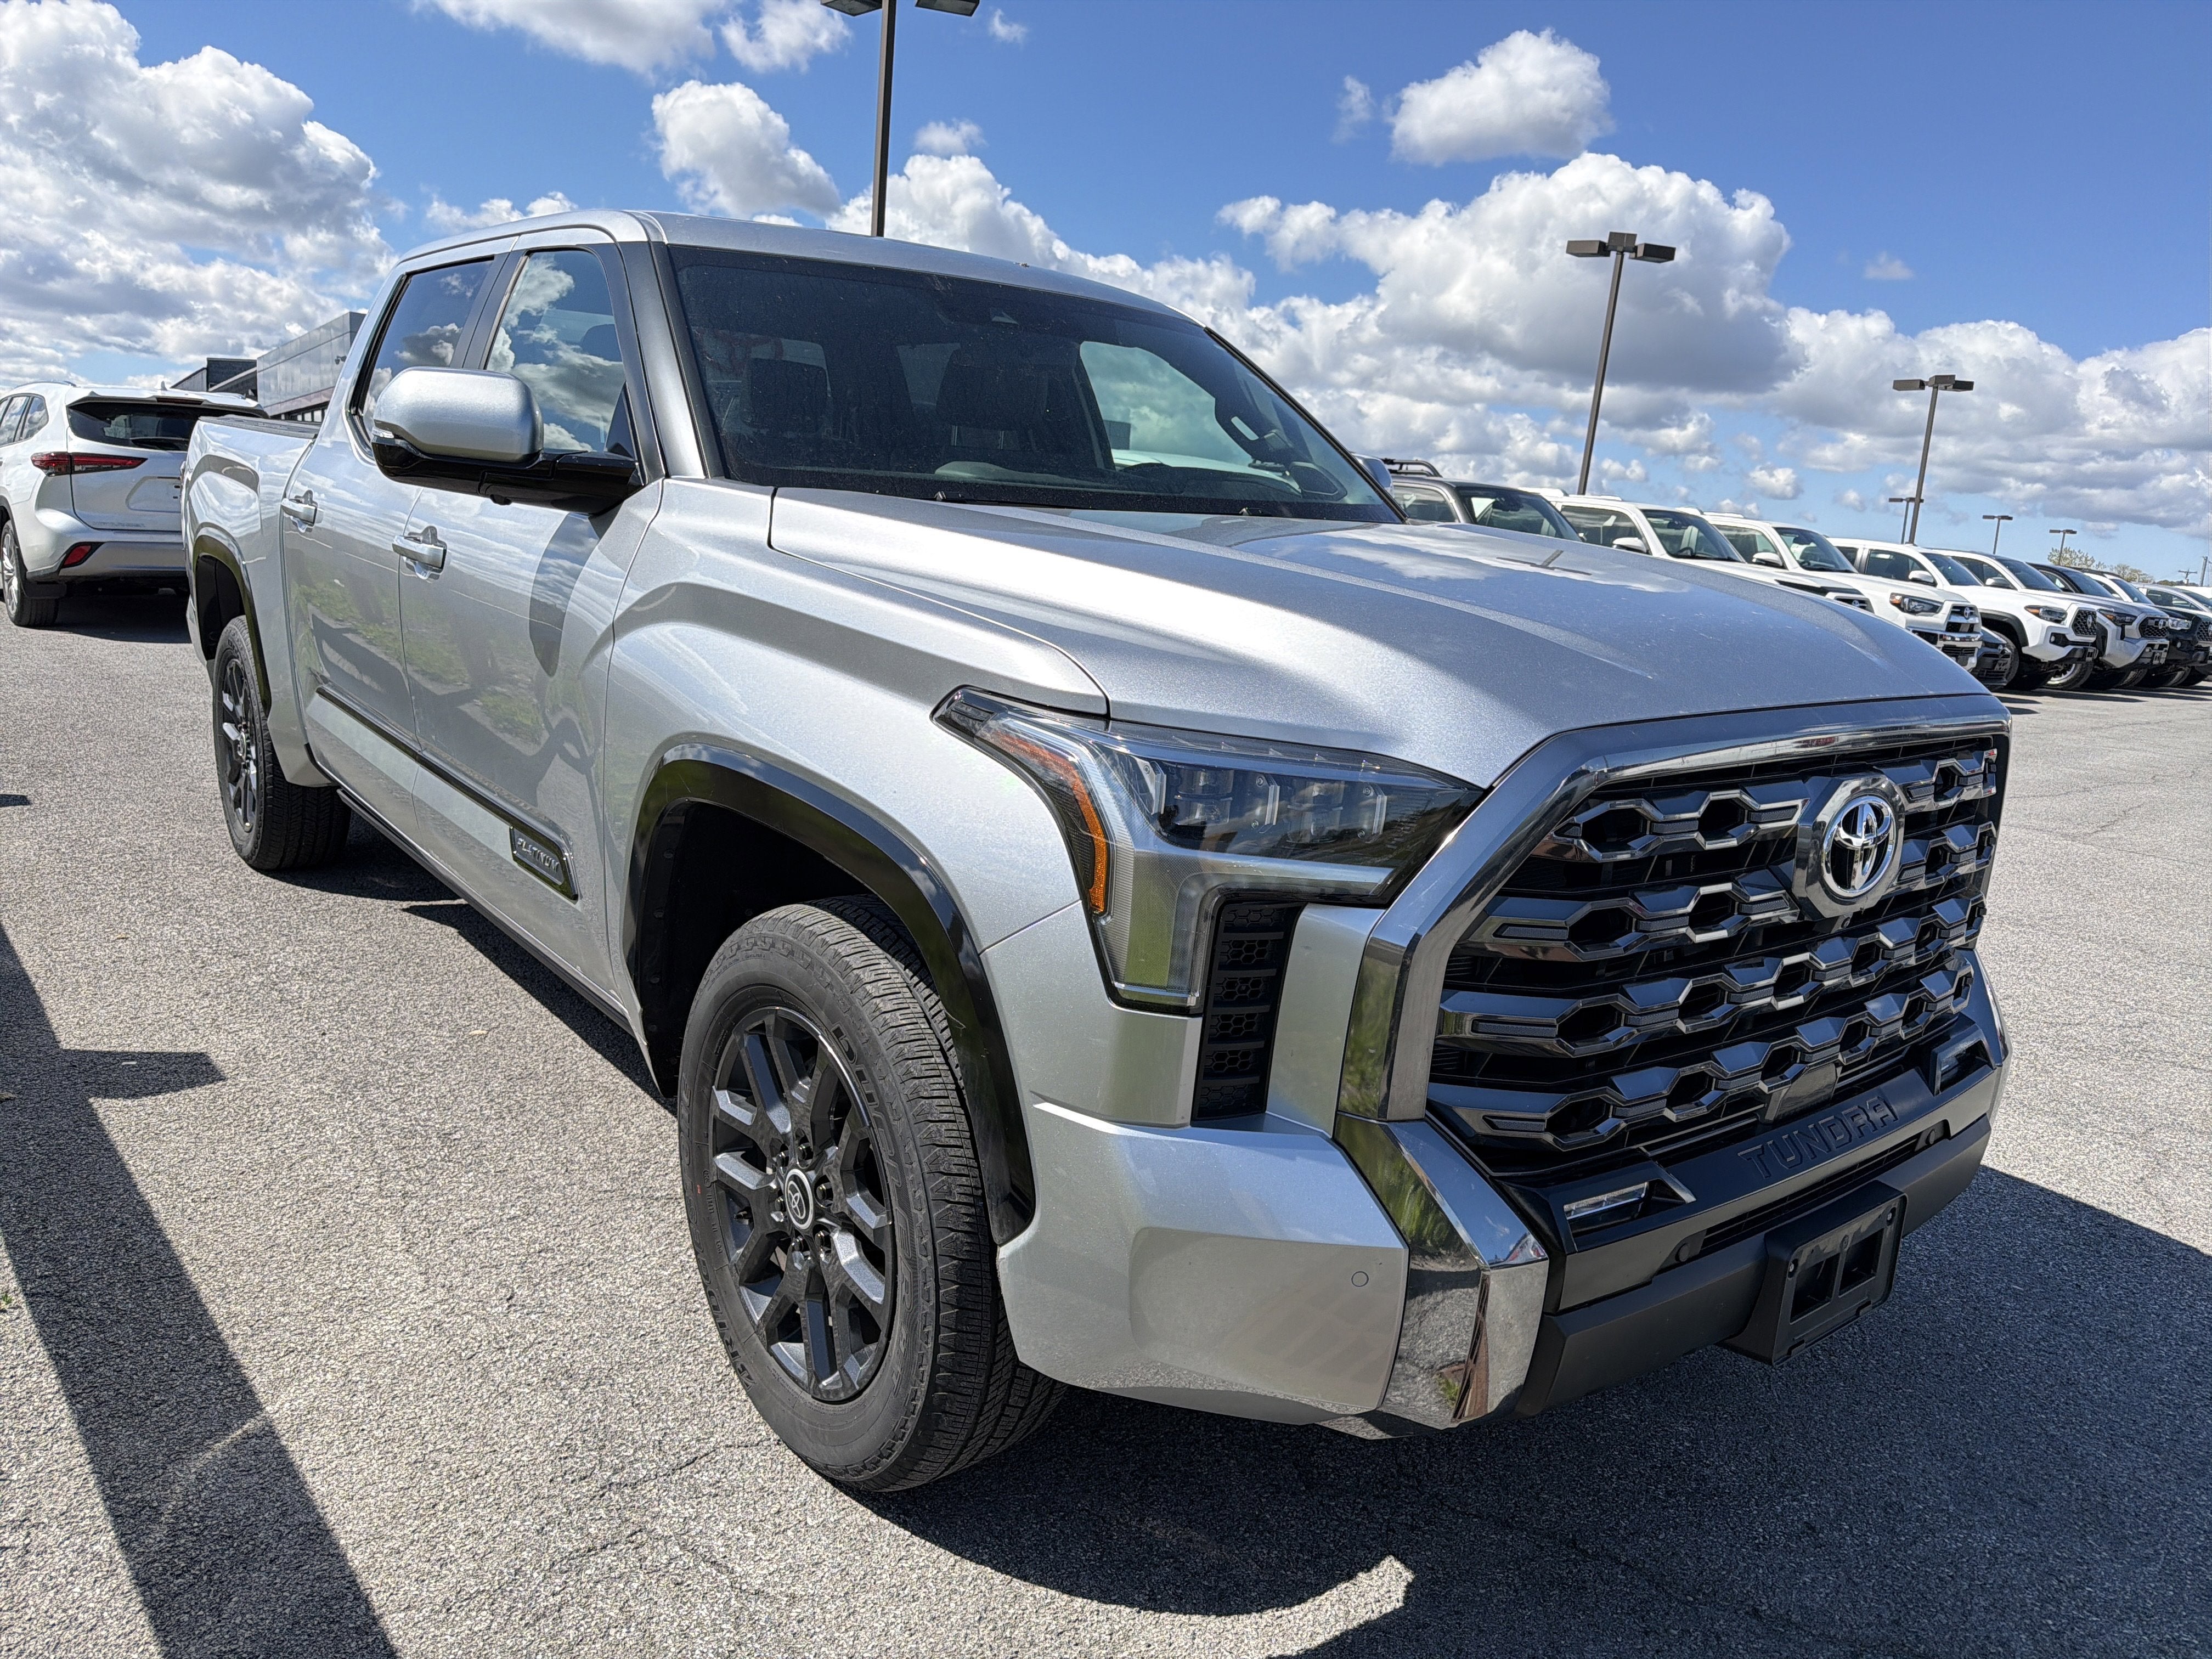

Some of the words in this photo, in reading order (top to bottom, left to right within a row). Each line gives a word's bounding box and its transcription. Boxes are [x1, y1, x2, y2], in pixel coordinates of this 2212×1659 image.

[517, 838, 560, 873] PLATINUM
[831, 1022, 913, 1312] DUELER
[1737, 1096, 1899, 1179] TUNDRA
[680, 1074, 756, 1391] BRIDGESTONE
